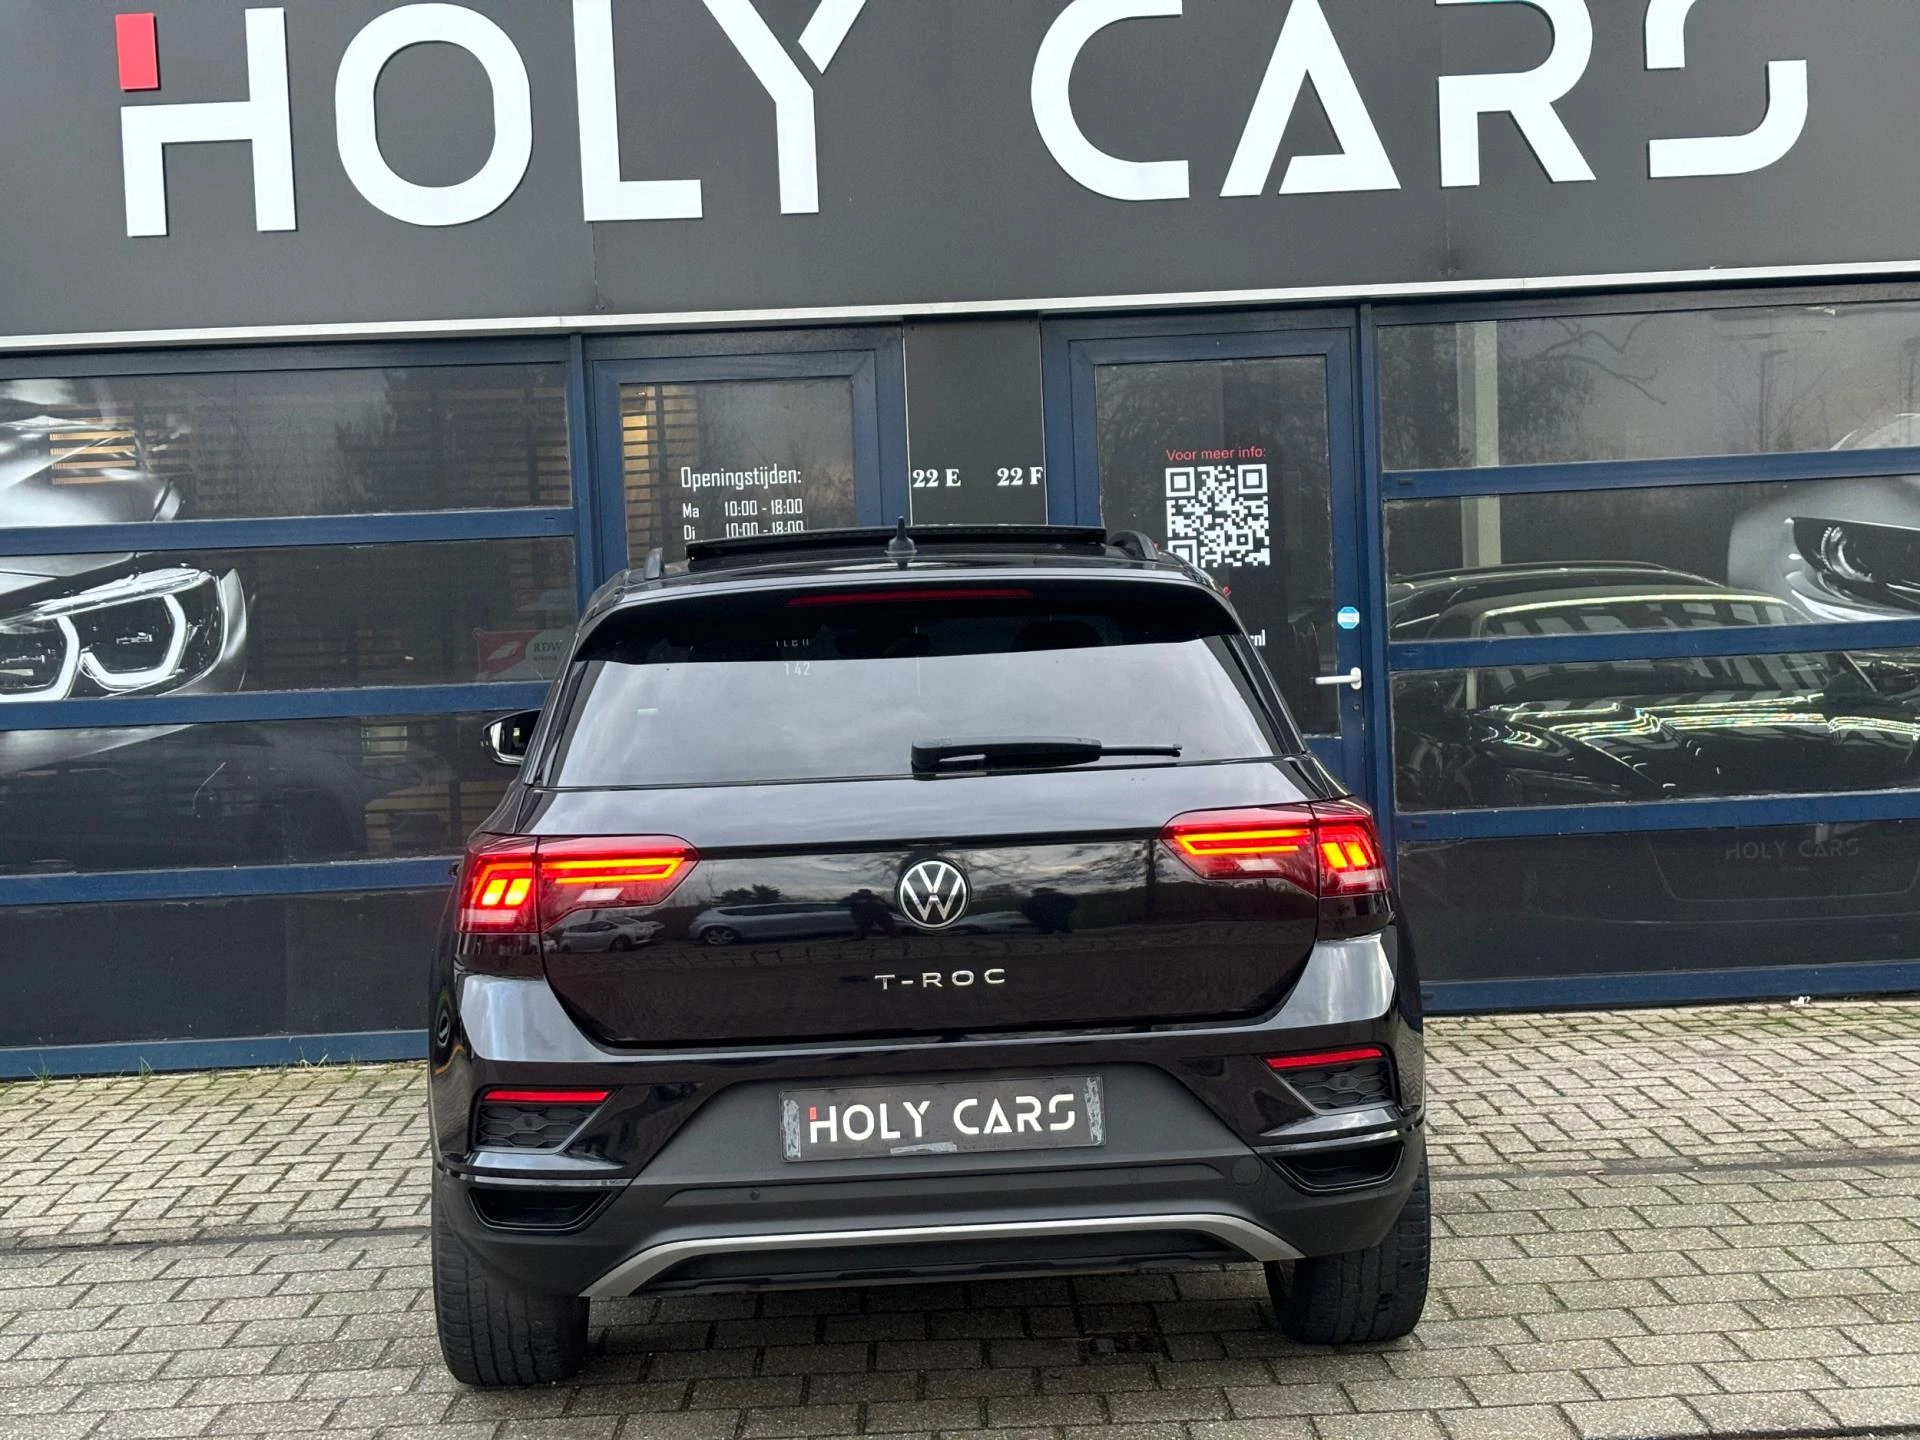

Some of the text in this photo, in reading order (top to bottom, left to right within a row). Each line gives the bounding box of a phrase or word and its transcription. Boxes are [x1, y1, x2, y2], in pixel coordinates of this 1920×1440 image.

[115, 0, 1808, 237] HOLY CARS
[1165, 445, 1266, 461] Voor meer info:
[680, 463, 802, 492] Openingstijden:
[912, 468, 961, 488] 22 E
[997, 466, 1044, 486] 22 F
[682, 503, 699, 518] Ma
[725, 500, 758, 517] 10:00
[770, 498, 803, 515] 18:00
[683, 524, 696, 541] Di
[1725, 837, 1860, 860] HOLY CARS
[874, 968, 1005, 990] T-ROC
[809, 1094, 1075, 1143] HOLY CARS
